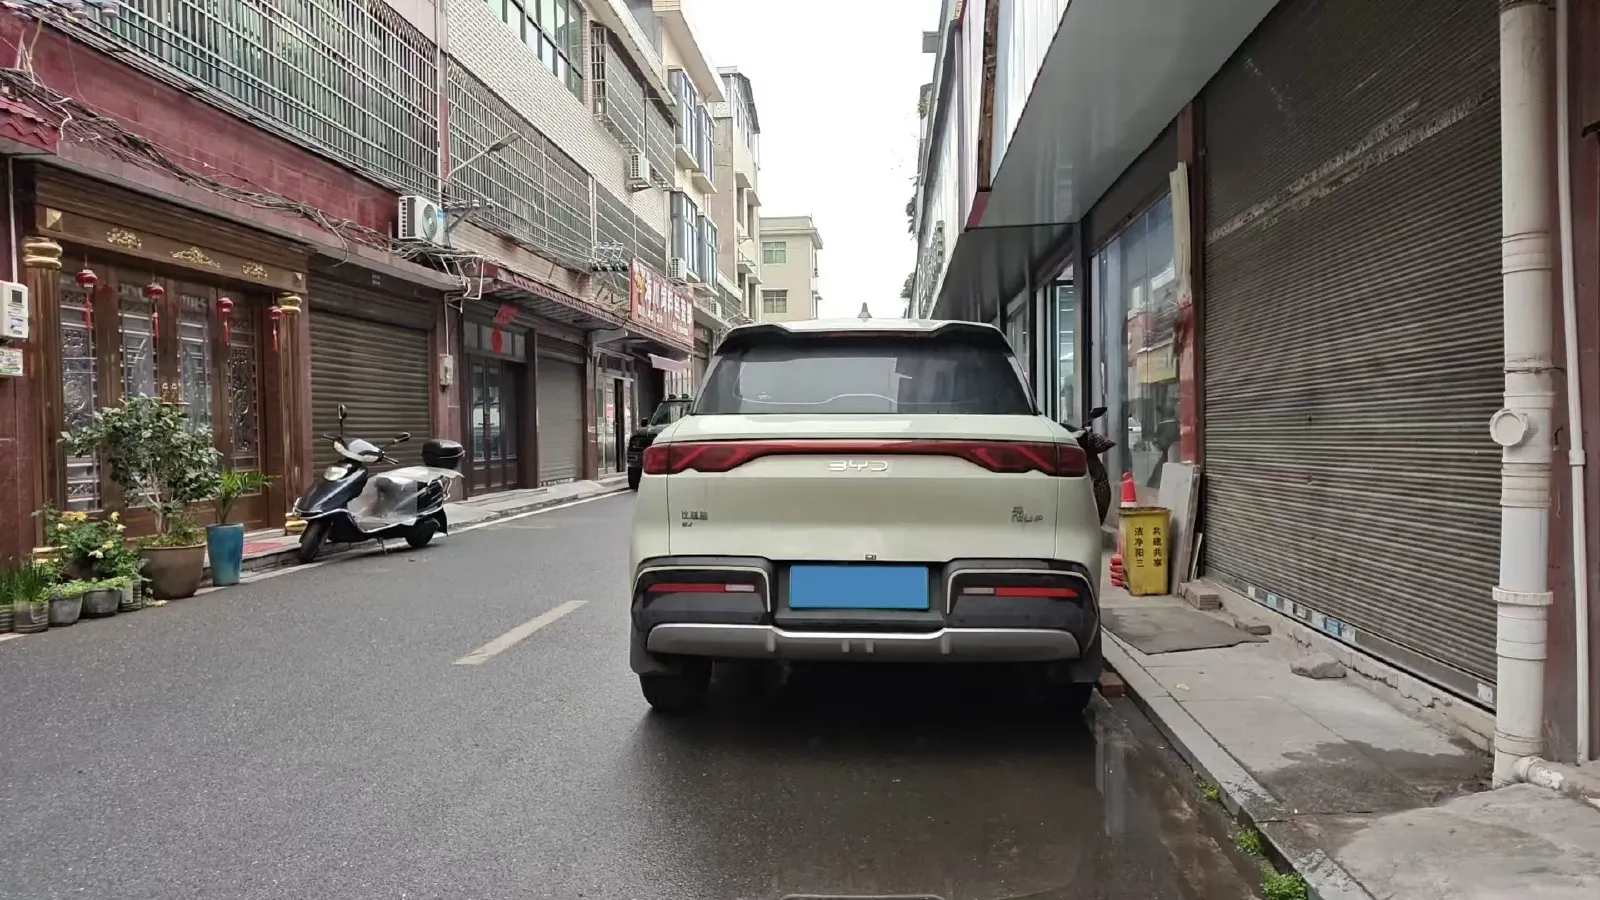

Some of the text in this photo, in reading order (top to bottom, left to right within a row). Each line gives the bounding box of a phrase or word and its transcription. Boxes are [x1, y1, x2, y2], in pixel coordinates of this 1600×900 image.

[828, 460, 888, 472] BYD
[1134, 527, 1145, 568] 洁净阳三
[1152, 526, 1162, 567] 共建共享
